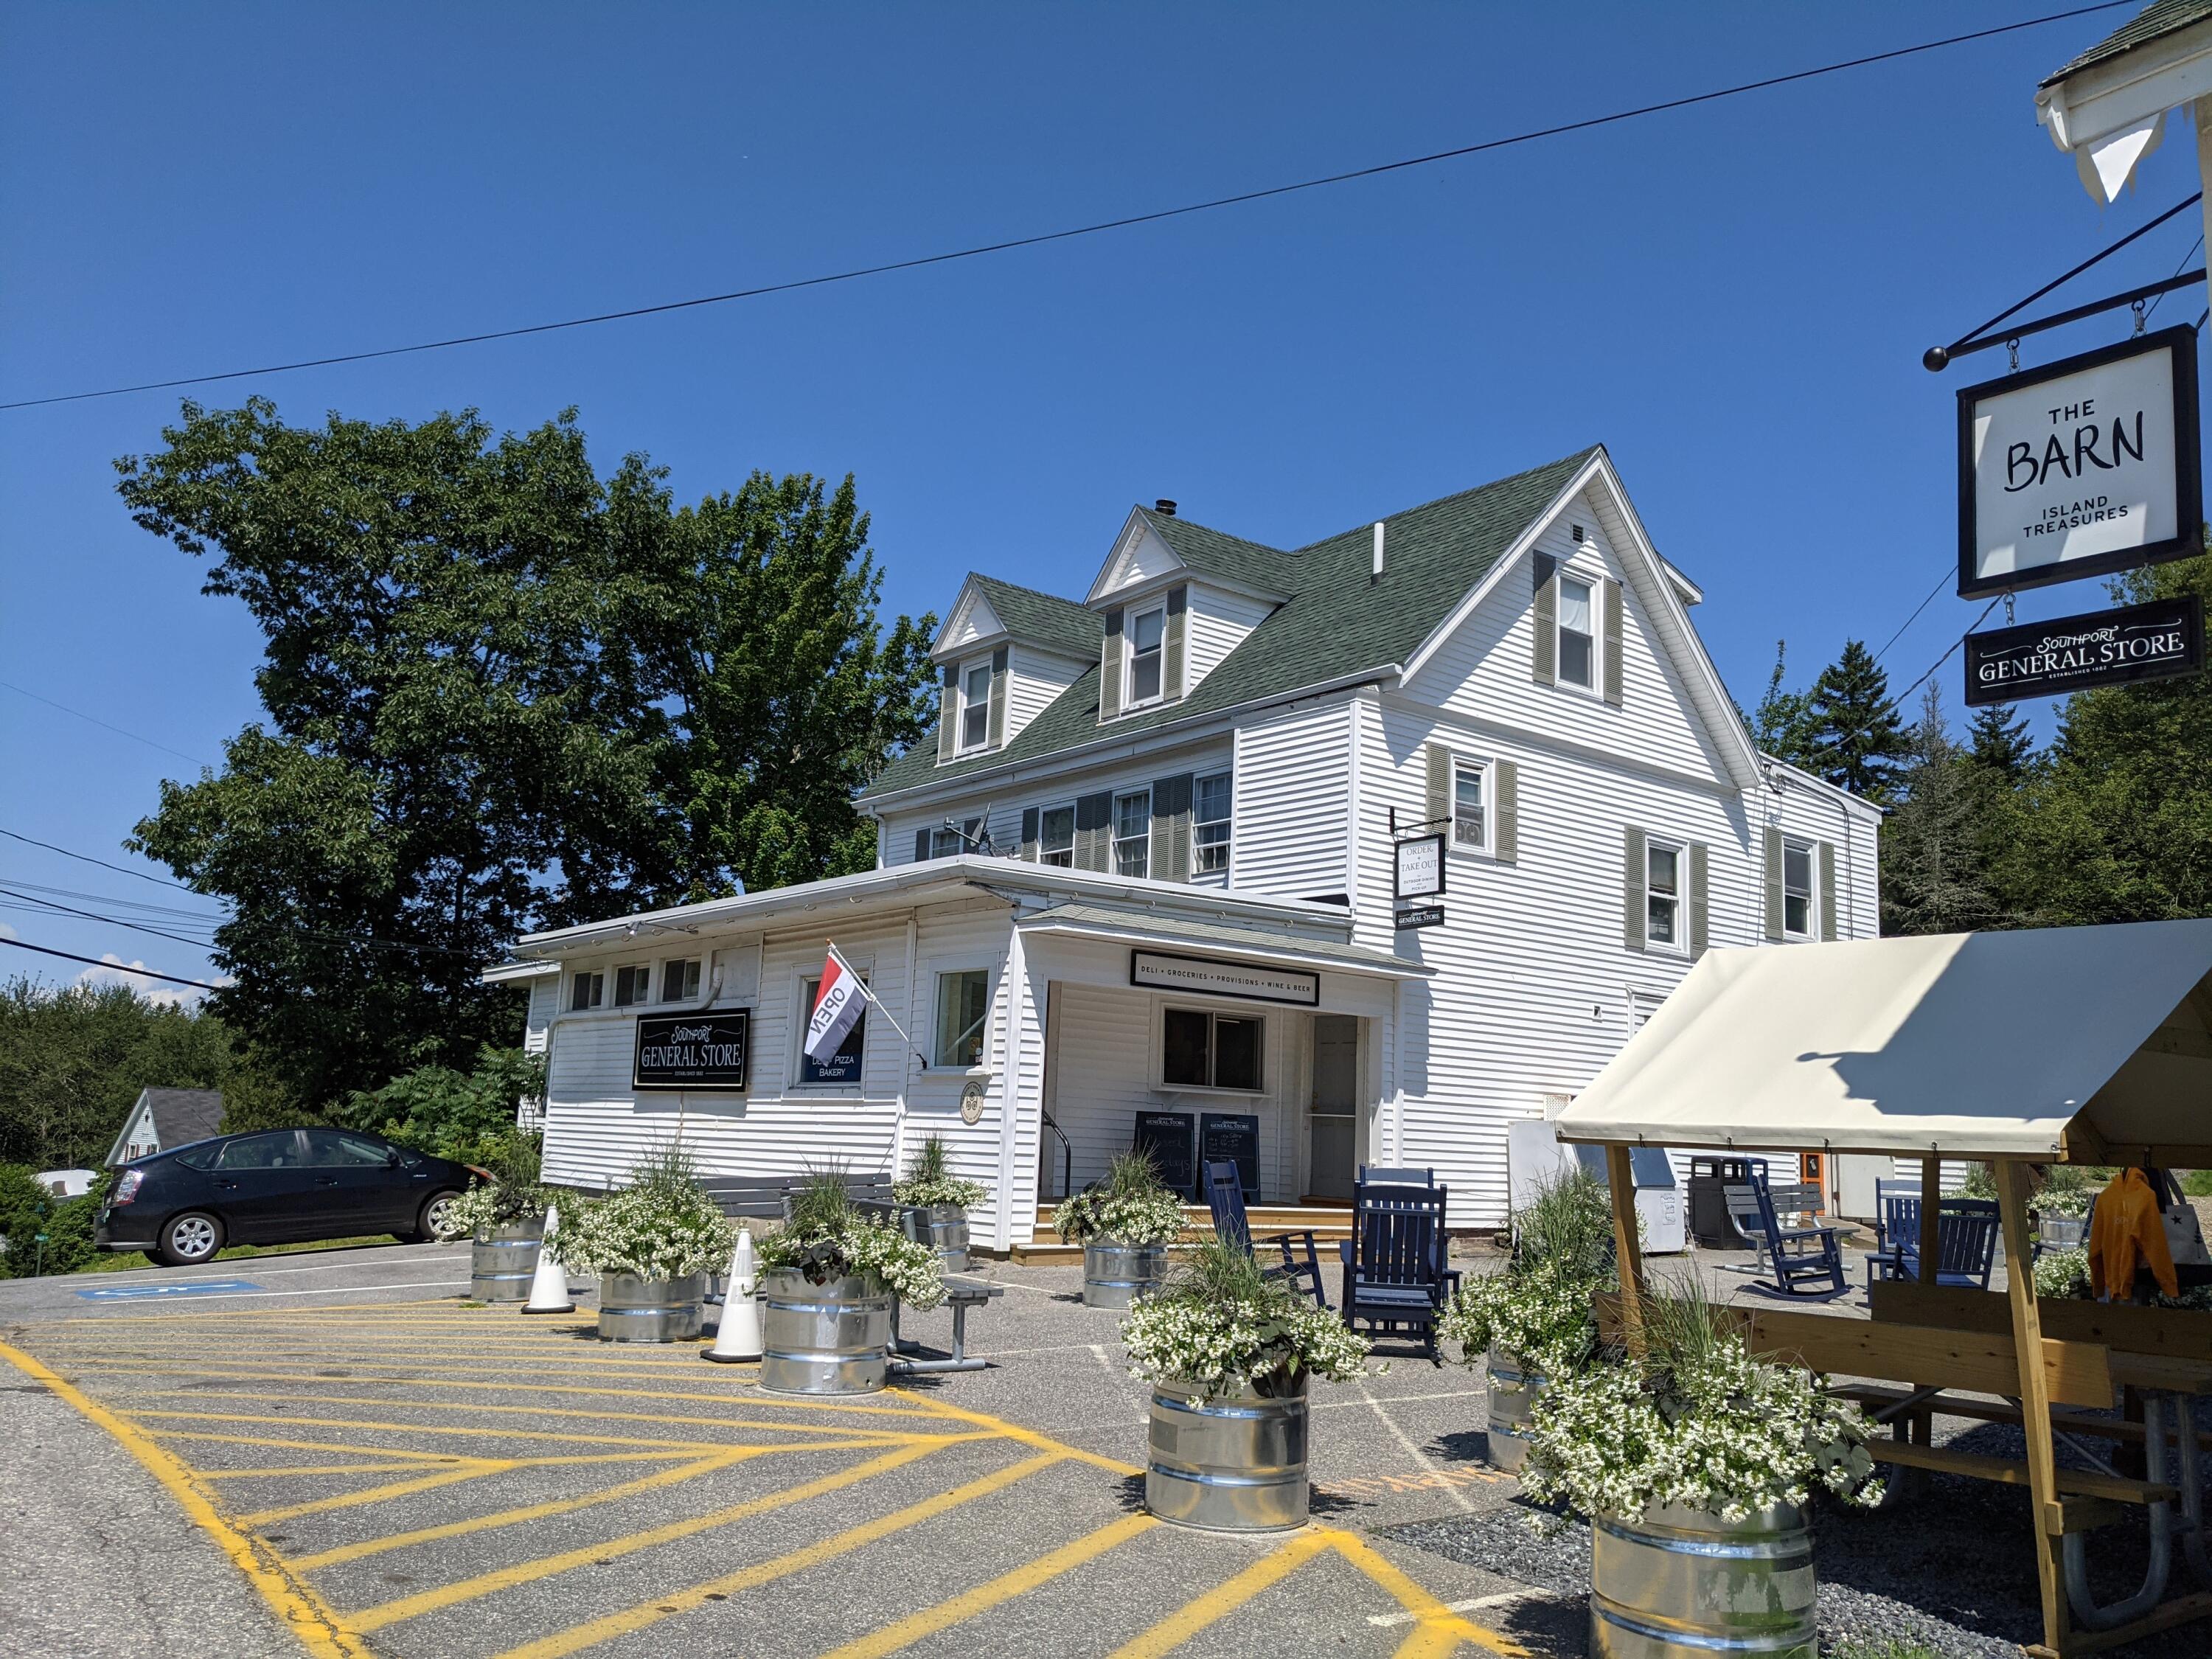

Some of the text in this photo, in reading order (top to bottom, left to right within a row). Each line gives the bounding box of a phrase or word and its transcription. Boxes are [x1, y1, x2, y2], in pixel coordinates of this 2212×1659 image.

[2048, 399, 2096, 425] THE
[2004, 411, 2144, 493] BARN
[2042, 495, 2109, 520] ISLAND
[2023, 504, 2129, 538] TREASURES
[1979, 632, 2185, 682] GENERAL STORE
[2048, 668, 2090, 679] ESTABLISHED
[1407, 845, 1433, 856] ORDER
[1400, 859, 1438, 872] TAKE OUT
[1398, 914, 1423, 924] GENERAL
[1423, 913, 1440, 922] STORE
[1167, 970, 1208, 979] GROCERIES
[1217, 975, 1259, 986] PROVISIONS
[641, 1044, 741, 1067] GENERAL STORE
[835, 1055, 855, 1064] PIZZA
[819, 1068, 846, 1077] BAKERY
